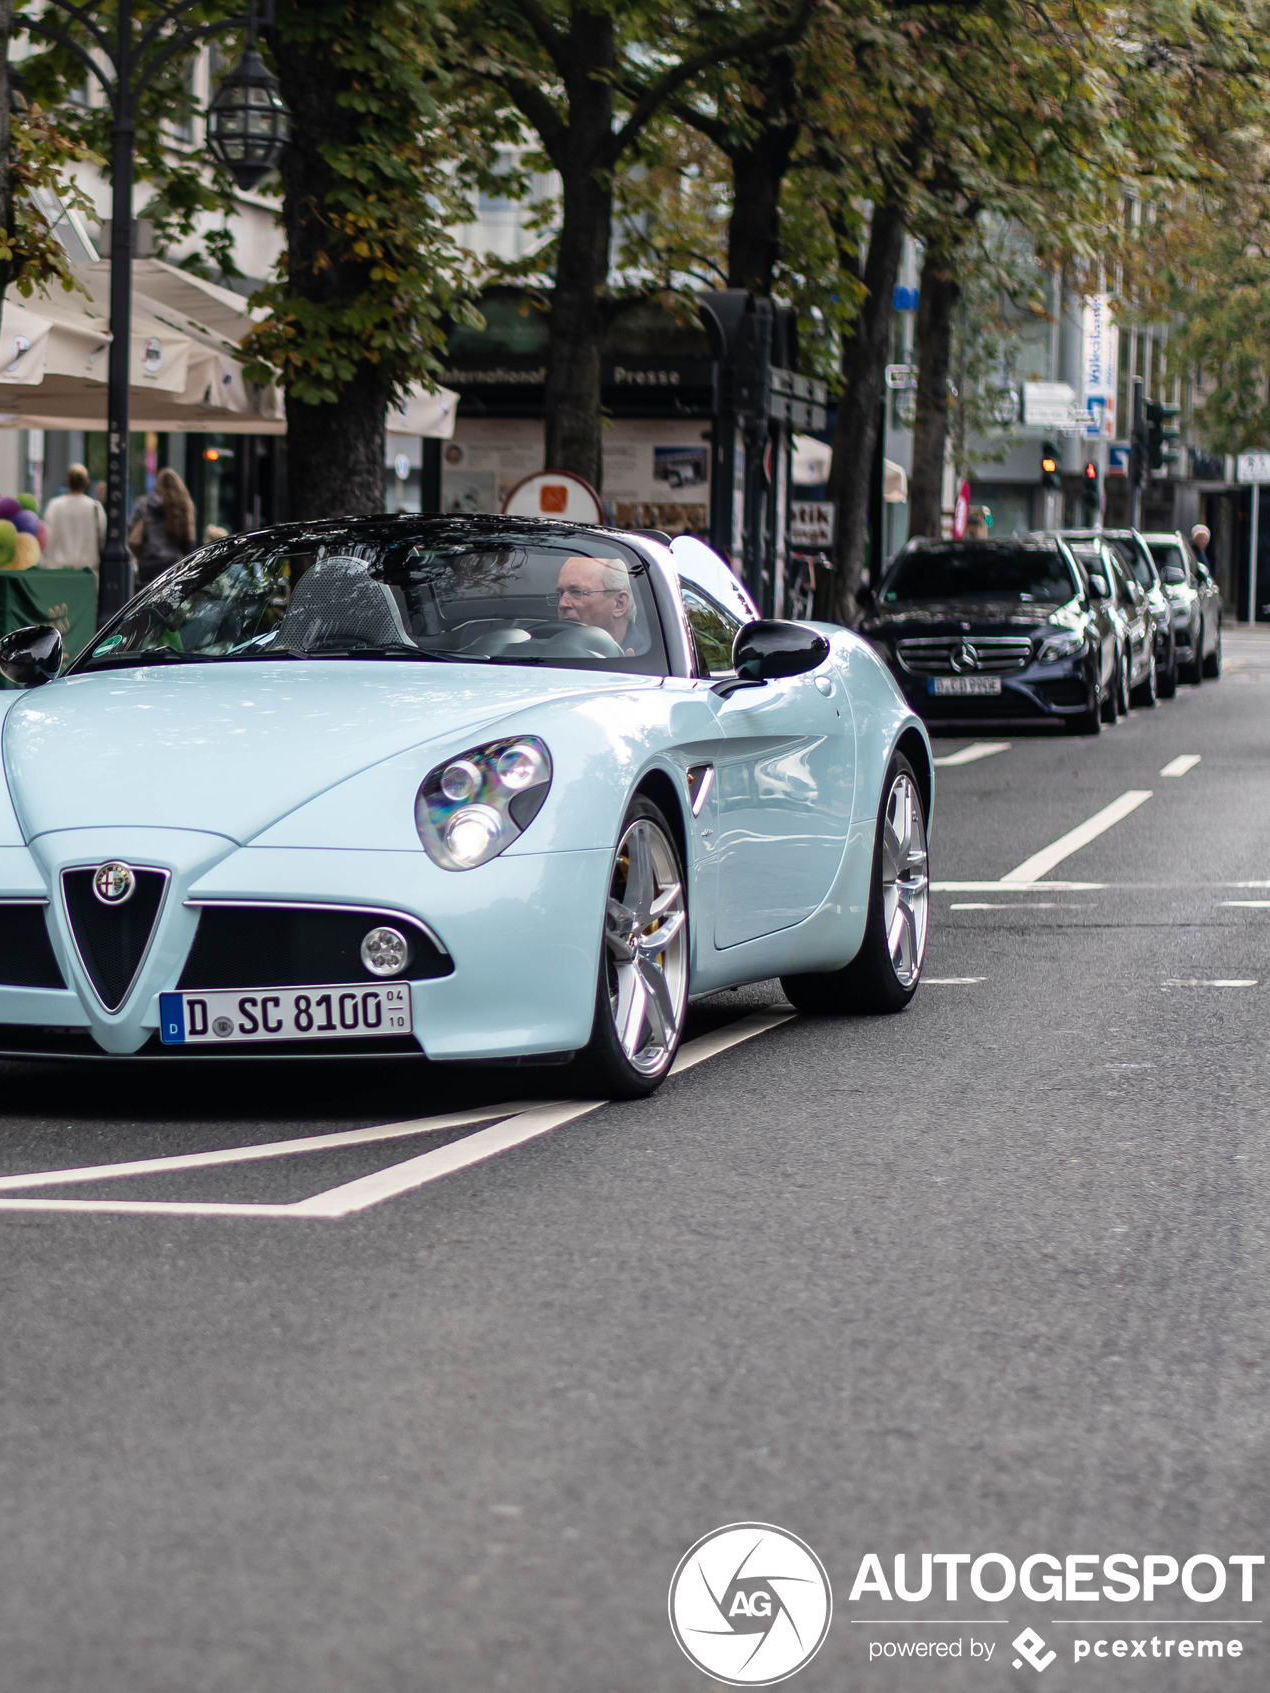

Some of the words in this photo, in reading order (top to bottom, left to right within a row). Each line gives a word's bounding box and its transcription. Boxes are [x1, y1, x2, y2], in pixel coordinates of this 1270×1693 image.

[613, 366, 679, 385] Presse
[386, 990, 404, 1001] 04
[187, 998, 208, 1035] D
[238, 996, 283, 1034] SC
[294, 992, 381, 1032] 8100
[389, 1016, 405, 1027] 10
[169, 1023, 178, 1034] D
